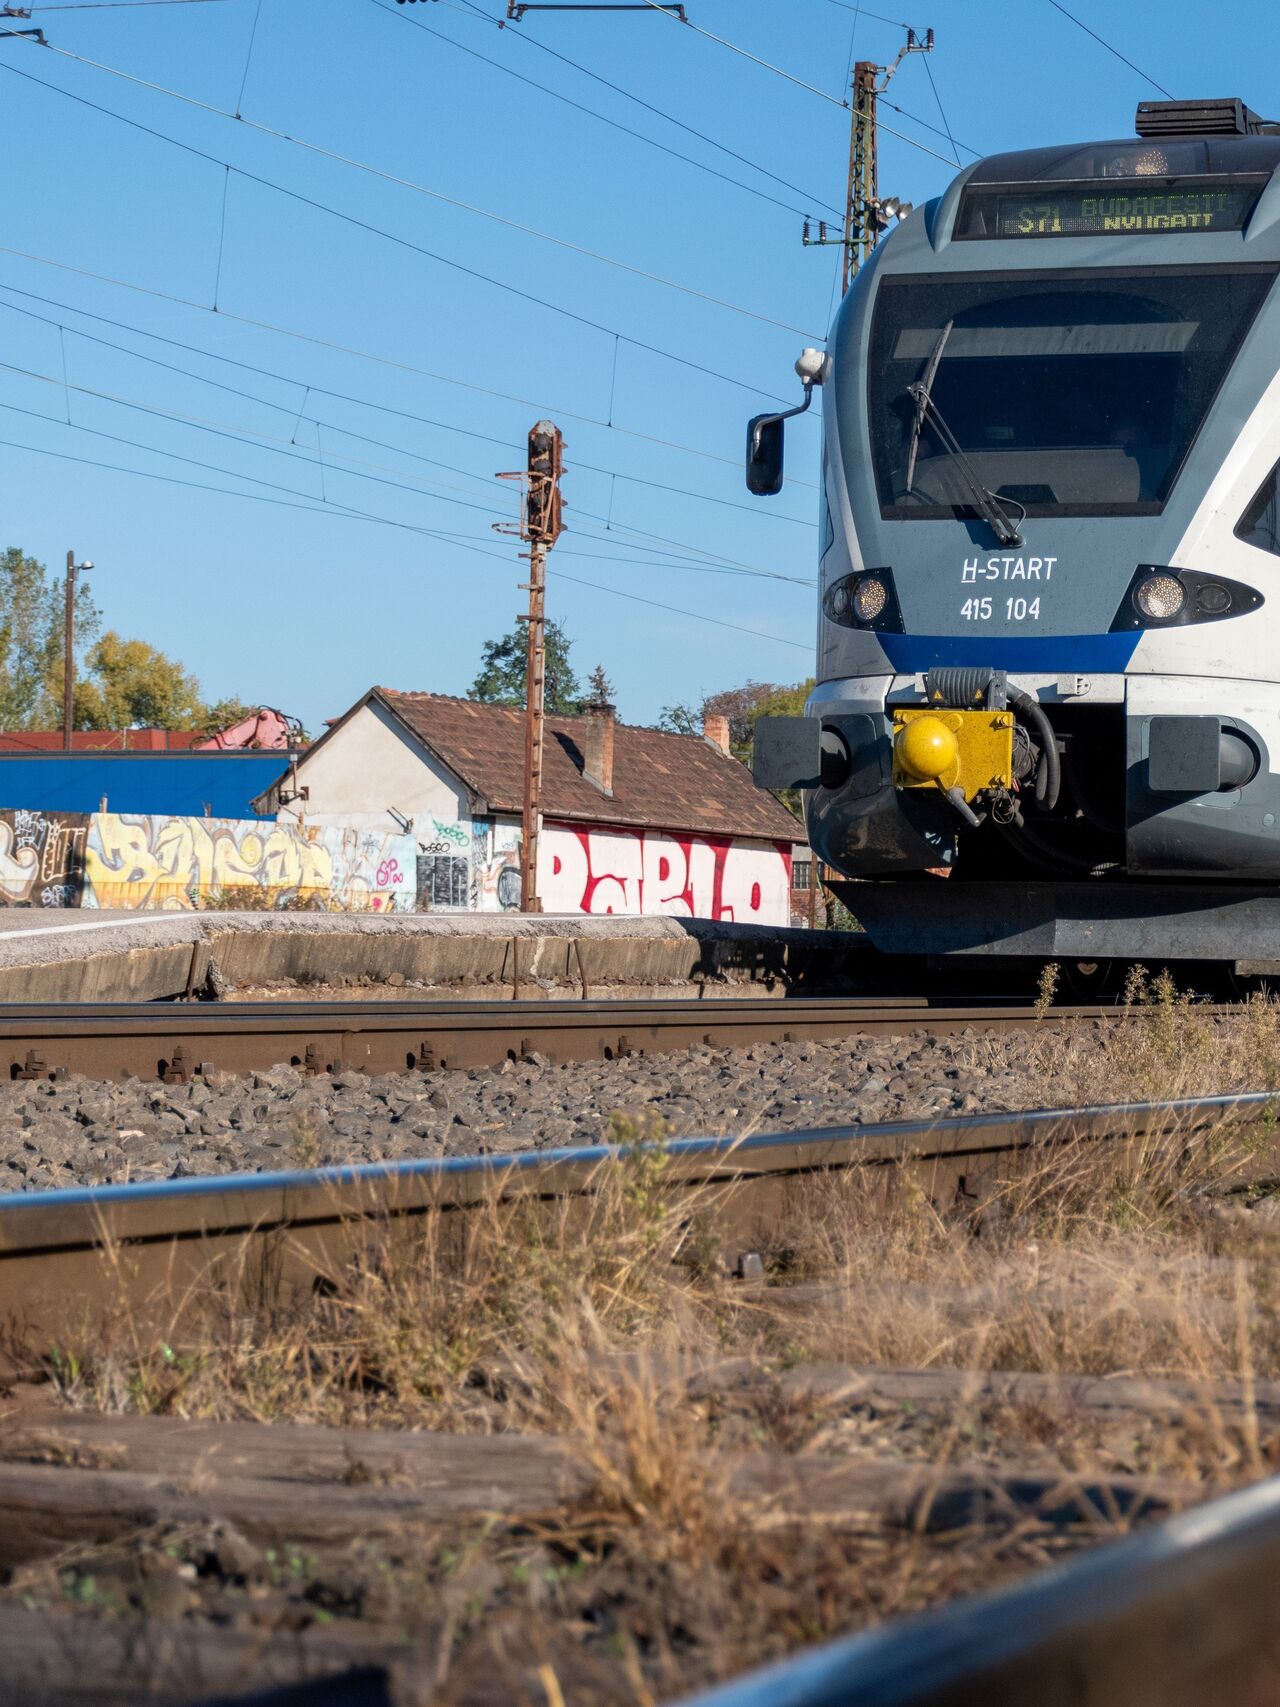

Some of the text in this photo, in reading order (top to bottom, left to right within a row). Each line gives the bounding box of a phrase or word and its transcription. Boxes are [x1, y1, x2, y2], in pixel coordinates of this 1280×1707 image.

[961, 557, 1058, 583] H-START
[960, 597, 1041, 620] 415 104
